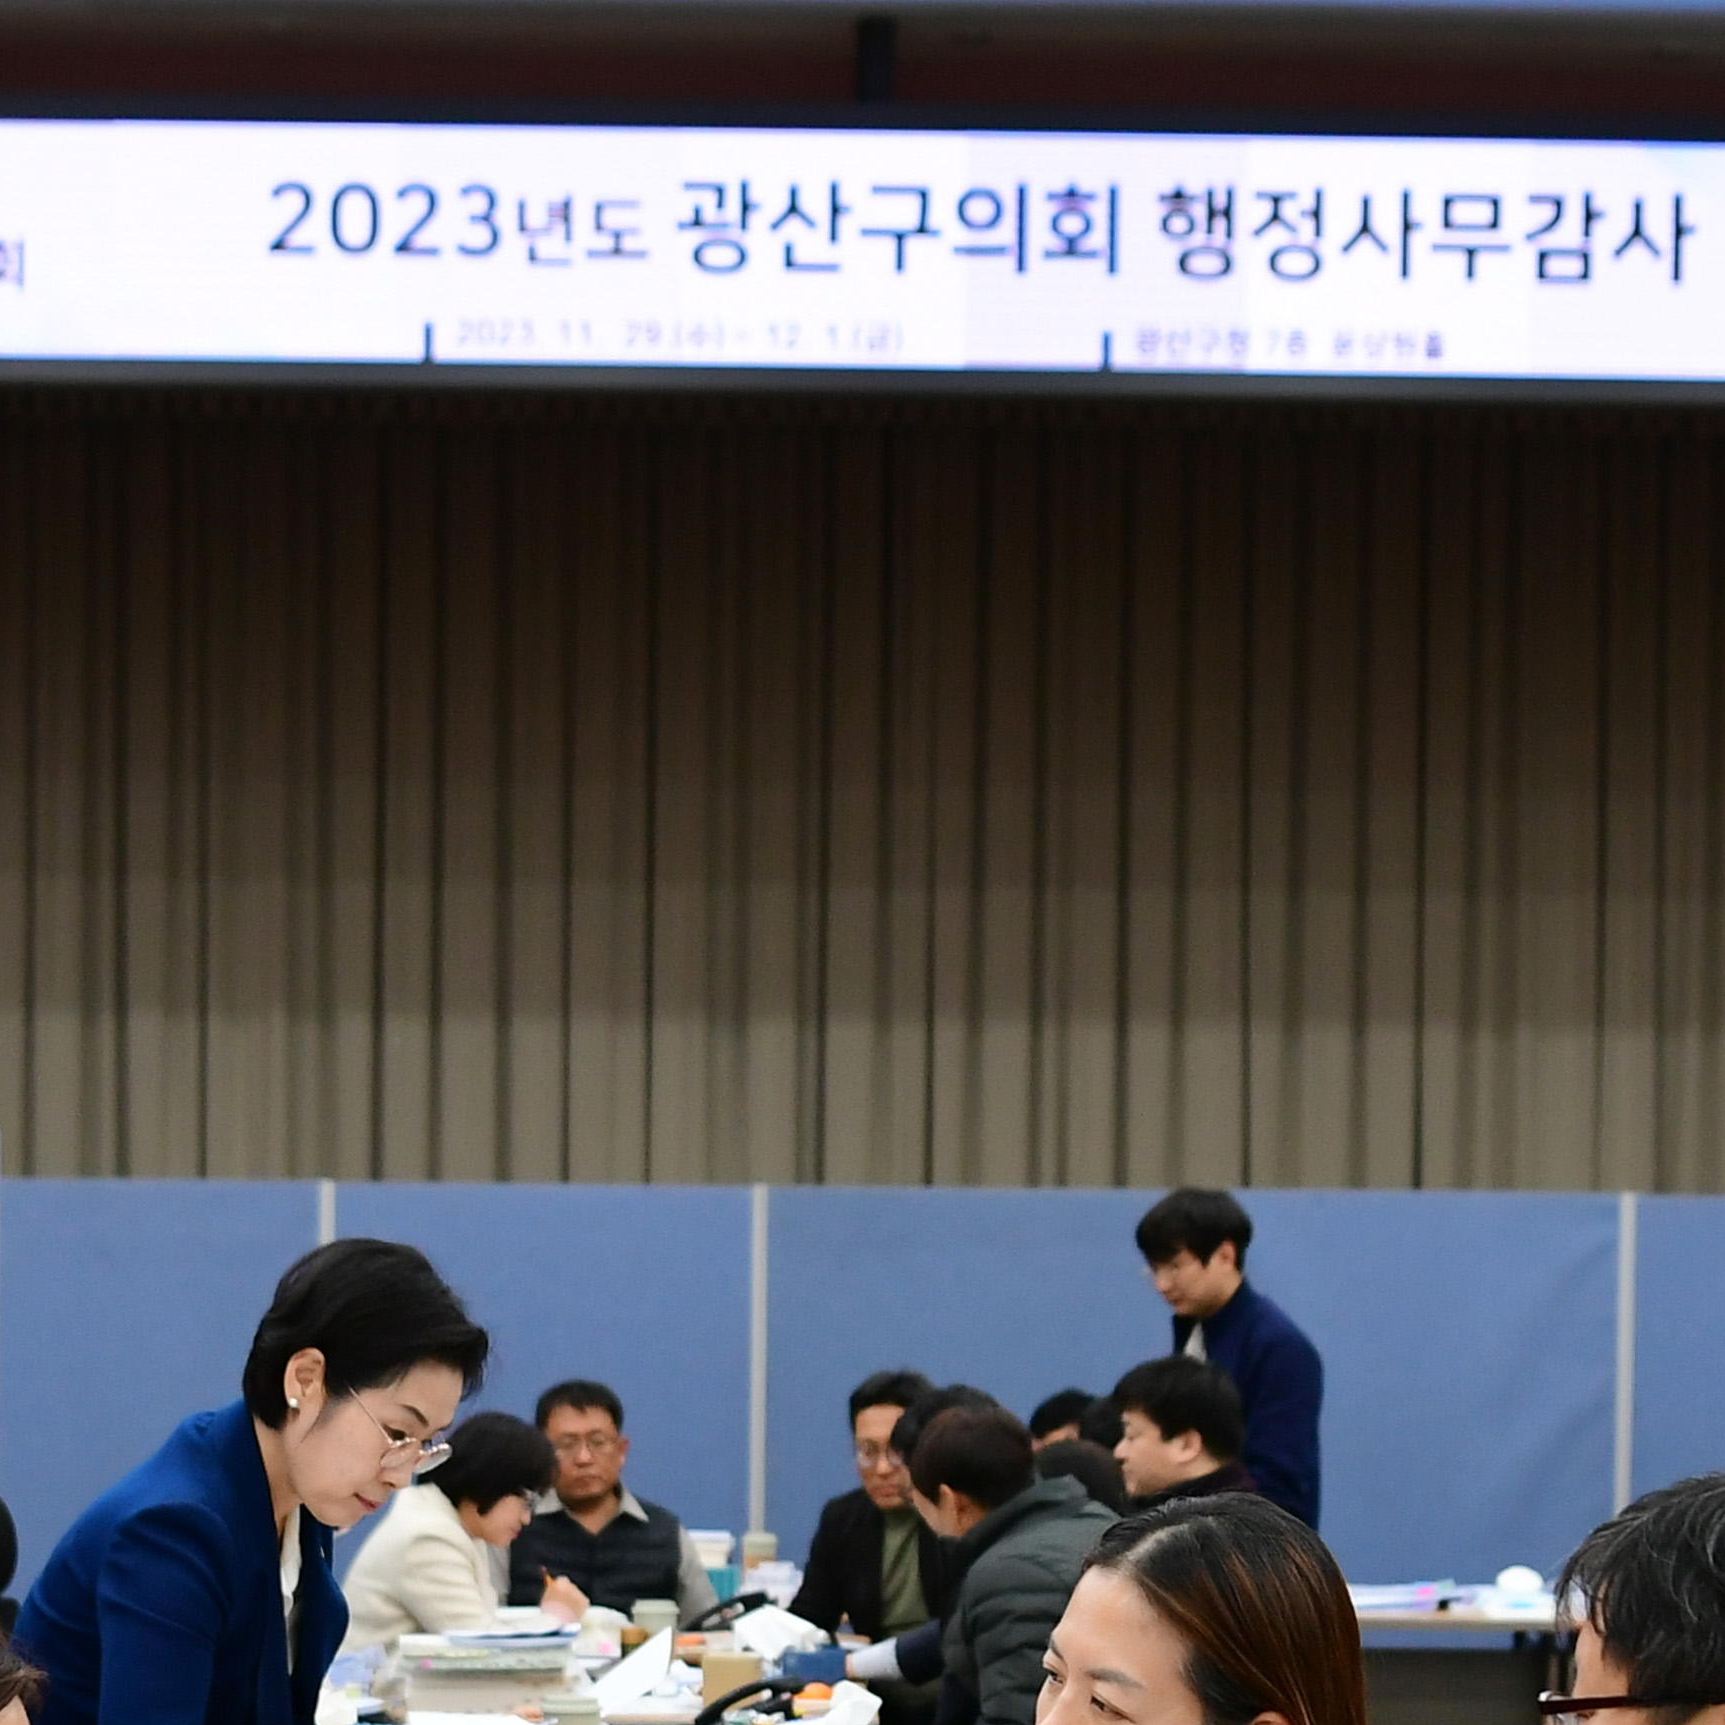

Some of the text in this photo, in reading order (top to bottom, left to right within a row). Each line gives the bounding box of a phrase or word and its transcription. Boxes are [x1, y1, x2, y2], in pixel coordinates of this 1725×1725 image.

[267, 178, 1698, 287] 2023년도 광산구의회 행정사무감사
